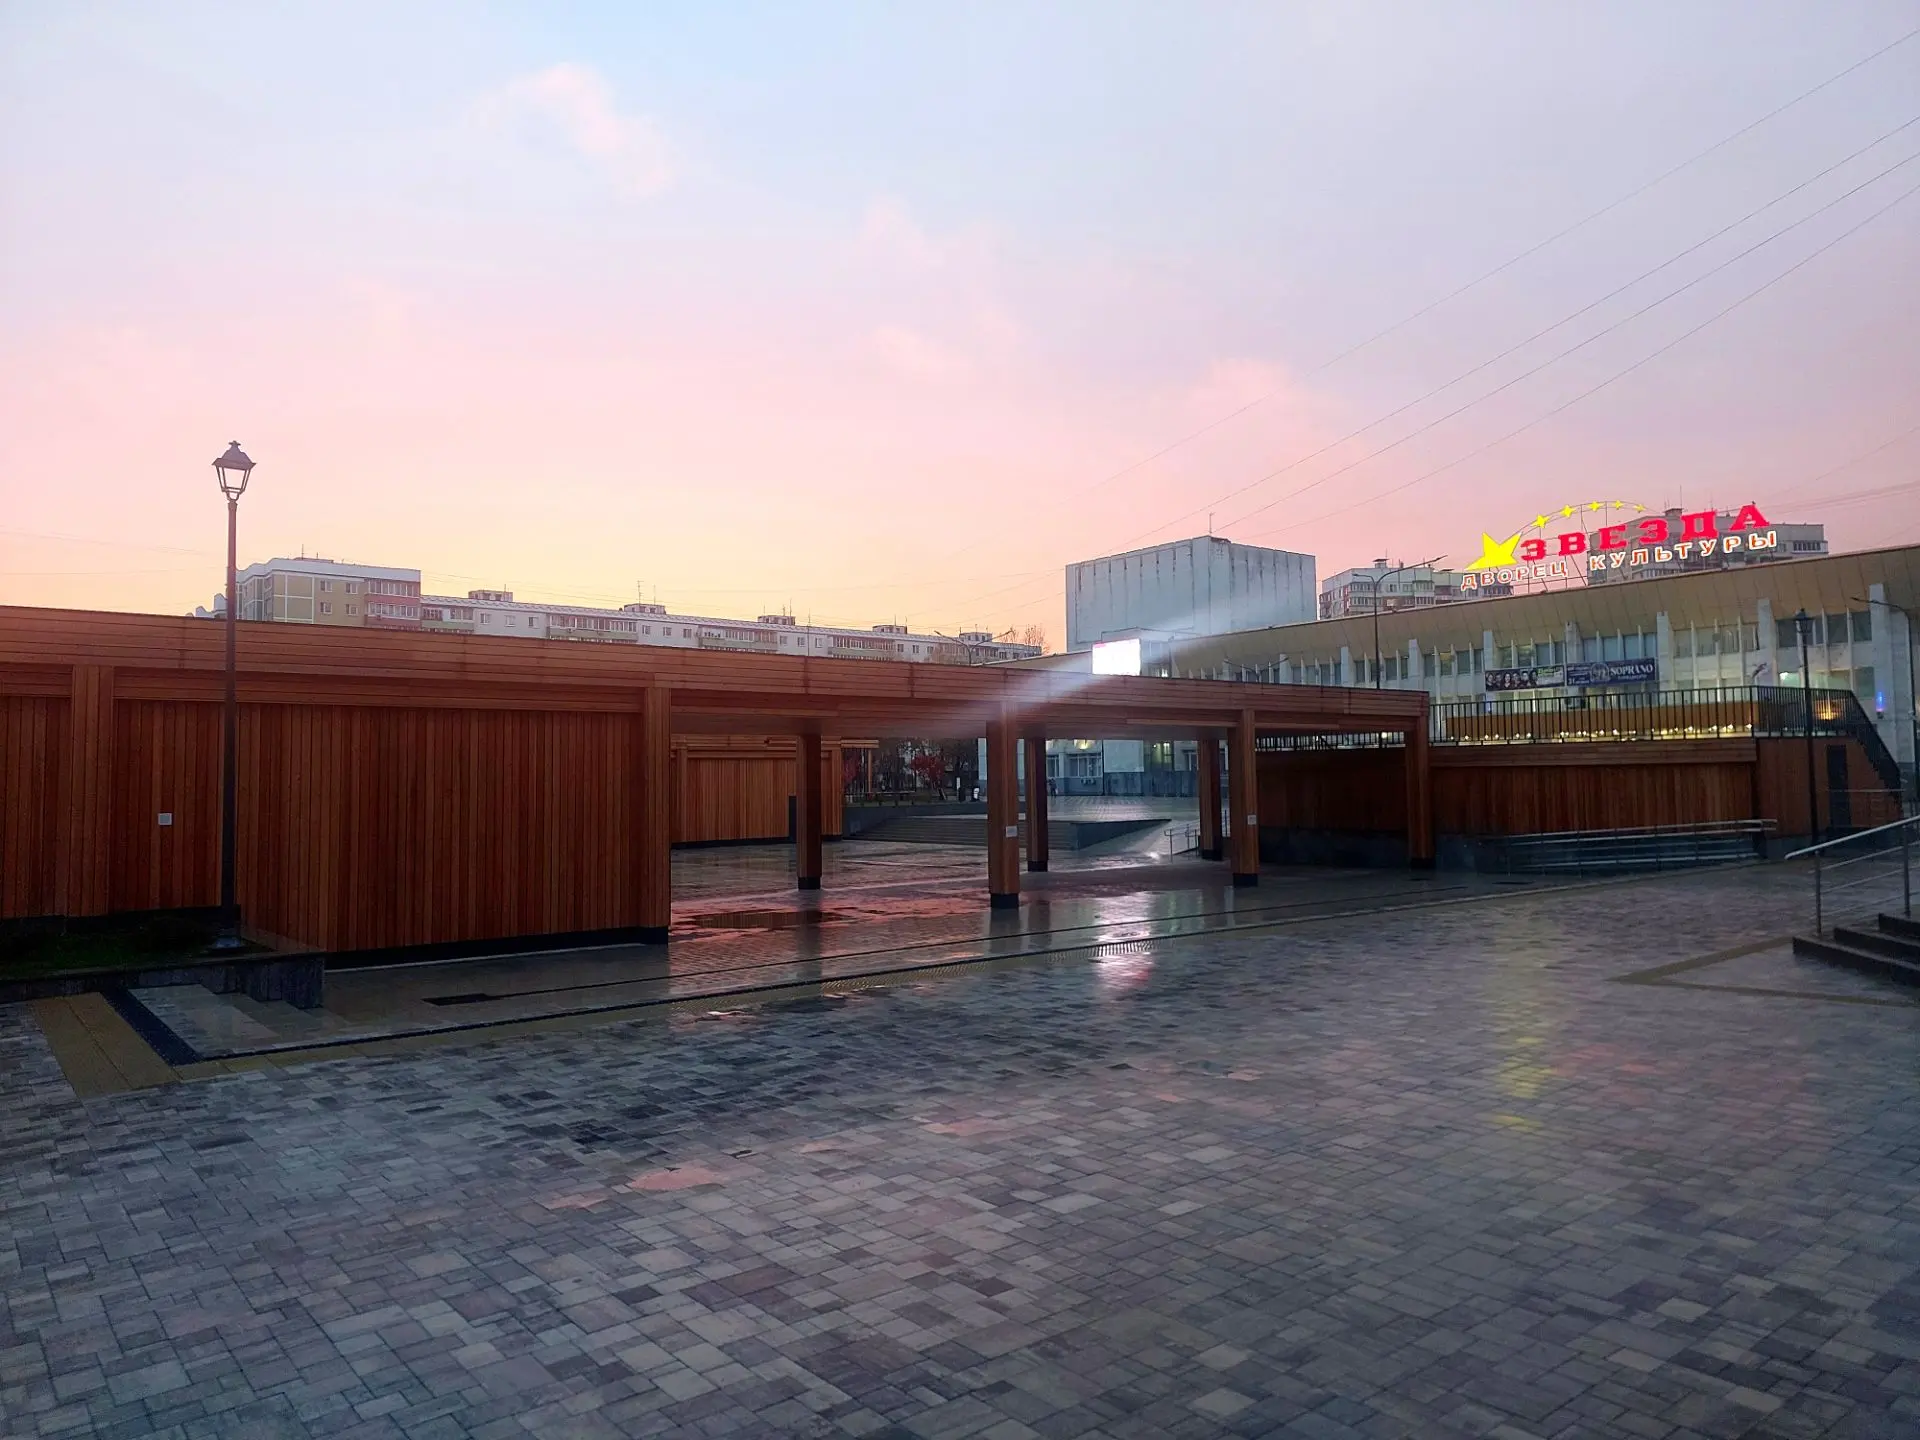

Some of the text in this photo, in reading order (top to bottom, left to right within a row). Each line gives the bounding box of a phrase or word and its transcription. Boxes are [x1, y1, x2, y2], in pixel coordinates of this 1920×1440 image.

[1461, 531, 1777, 591] ДВОРЕЦ КУЛЬТУРЫ
[1520, 504, 1770, 562] ЗВЕЗДА
[1610, 664, 1654, 675] SOPRANO
